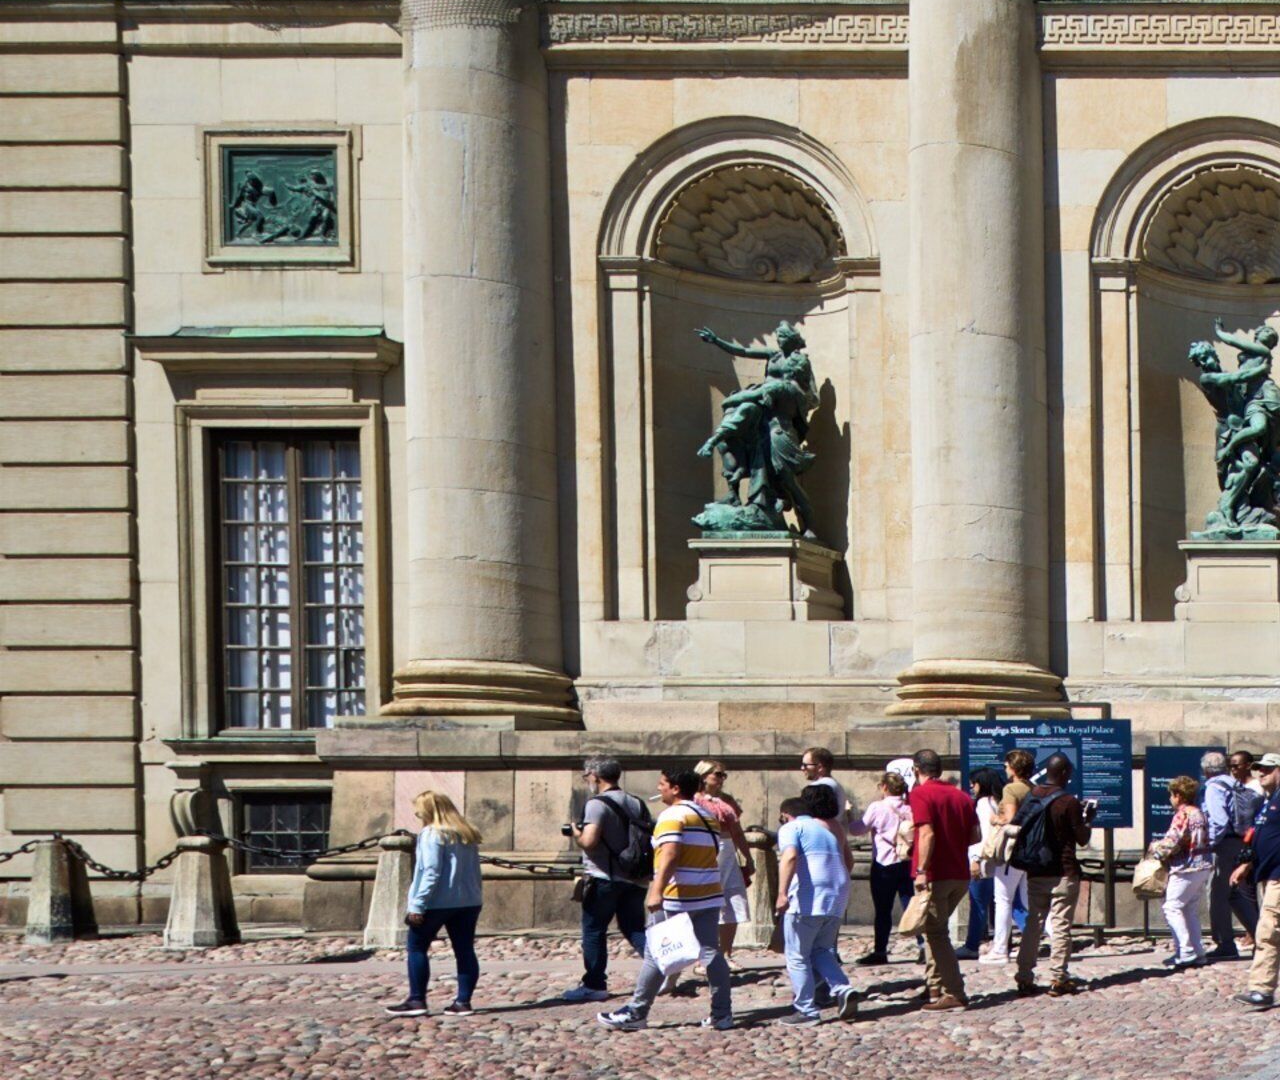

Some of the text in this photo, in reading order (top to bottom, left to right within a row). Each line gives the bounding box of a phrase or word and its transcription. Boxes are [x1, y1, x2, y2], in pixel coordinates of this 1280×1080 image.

[976, 726, 1034, 736] Kungliga Slottet
[1053, 726, 1114, 736] The Royal Palace
